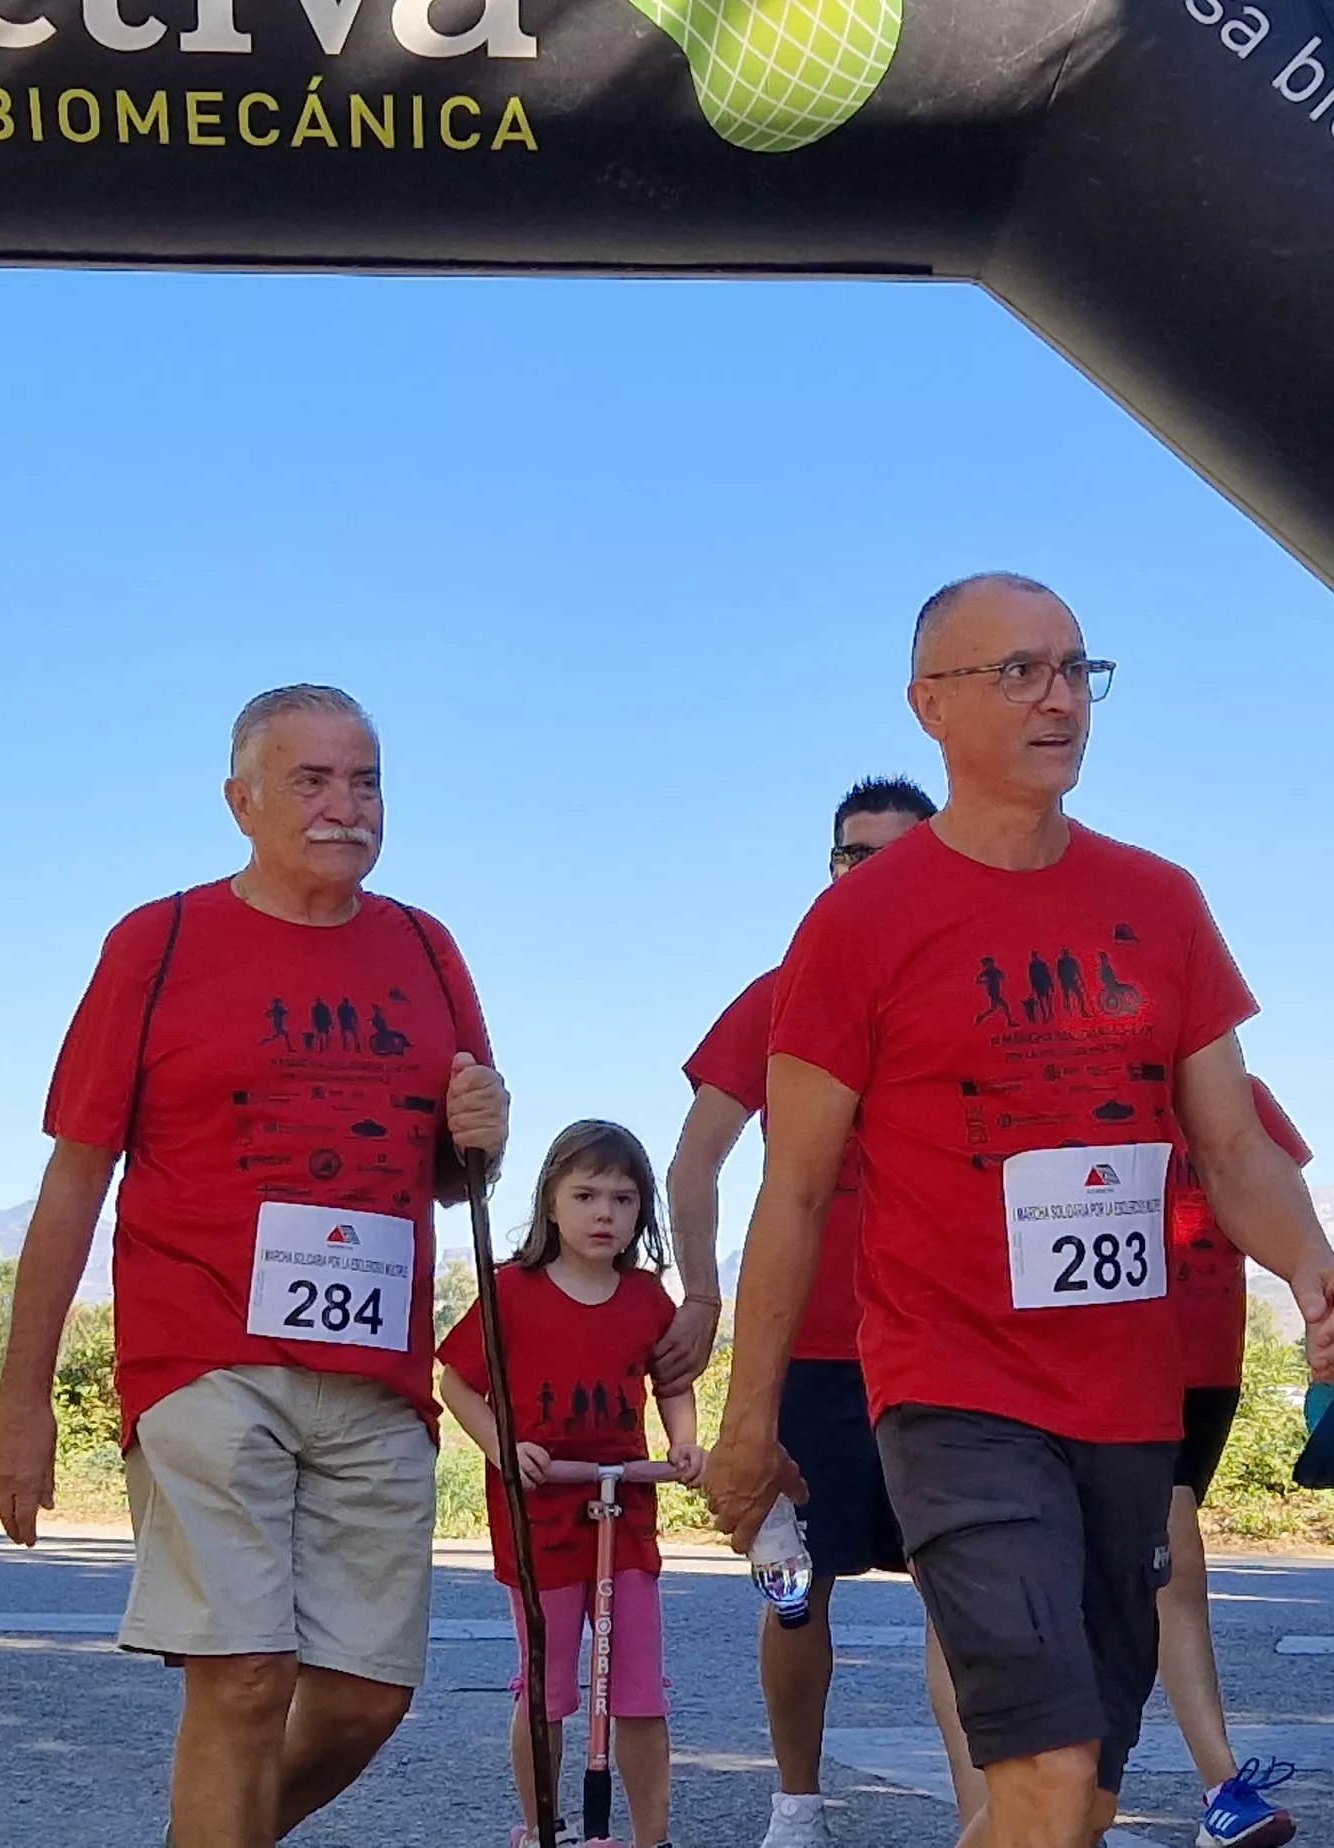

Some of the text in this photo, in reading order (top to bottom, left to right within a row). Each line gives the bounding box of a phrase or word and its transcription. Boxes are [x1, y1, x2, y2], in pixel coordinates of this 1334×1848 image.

[1051, 1231, 1148, 1293] 283
[283, 1279, 383, 1335] 284
[594, 1578, 614, 1717] GLOBBER
